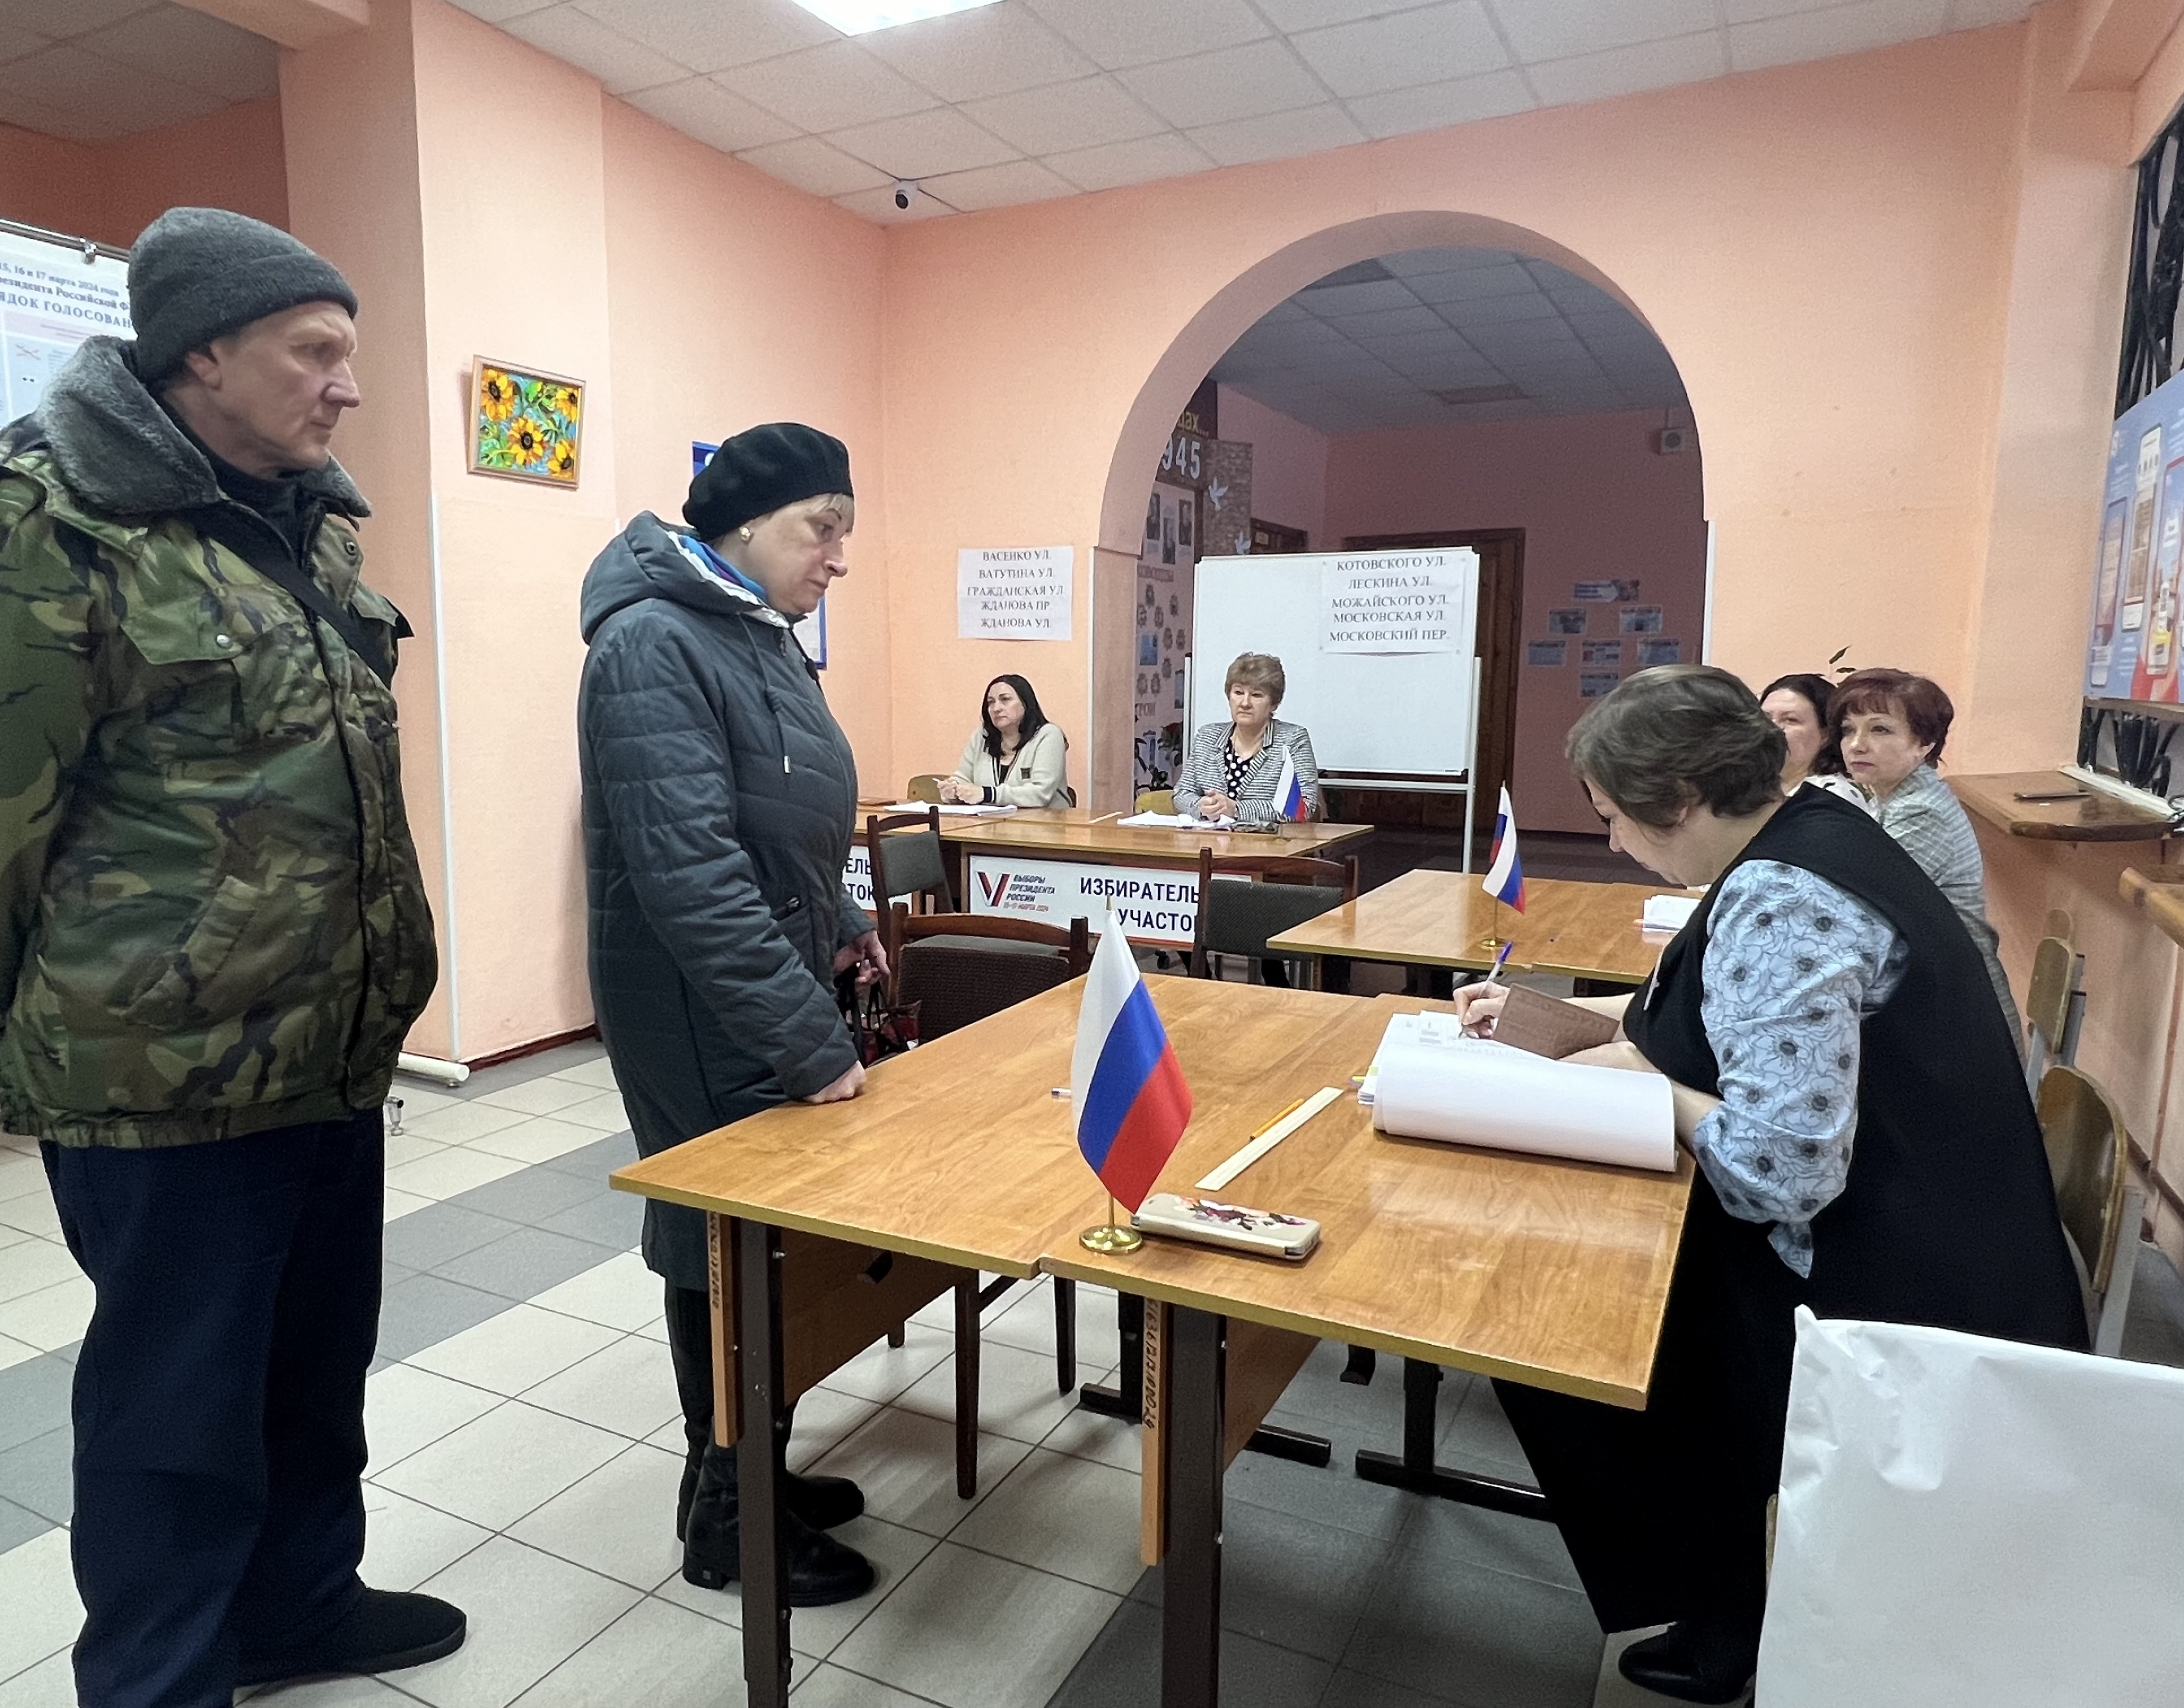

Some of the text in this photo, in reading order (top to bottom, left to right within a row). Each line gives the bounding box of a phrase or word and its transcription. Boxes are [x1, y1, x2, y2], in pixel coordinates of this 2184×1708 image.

[15, 265, 25, 275] 16
[36, 270, 46, 279] 17
[56, 286, 117, 309] Российской
[982, 551, 1032, 561] ВАСЕНКО
[1337, 556, 1447, 572] КОТОВСКОГО УЛ.
[978, 568, 1035, 579] ВАТУТИНА
[1348, 577, 1408, 590] ЛЕСКИНА
[967, 586, 1046, 596] ГРАЖДАНСКАЯ
[981, 600, 1034, 611] ЖДАНОВА
[1332, 594, 1449, 609] МОЖАЙСКОГО УЛ.
[1334, 611, 1422, 623] МОСКОВСКАЯ
[980, 618, 1032, 629] ЖДАНОВА
[1329, 628, 1450, 642] МОСКОВСКИЙ ПЕР.
[1013, 874, 1046, 883] ВЫБОРЫ
[1010, 884, 1056, 894] ПРЕЗИДЕНТА
[1080, 877, 1199, 904] ИЗБИРАТЕЛЬ
[1006, 893, 1036, 902] РОССИИ
[1118, 908, 1192, 932] УЧАСТО
